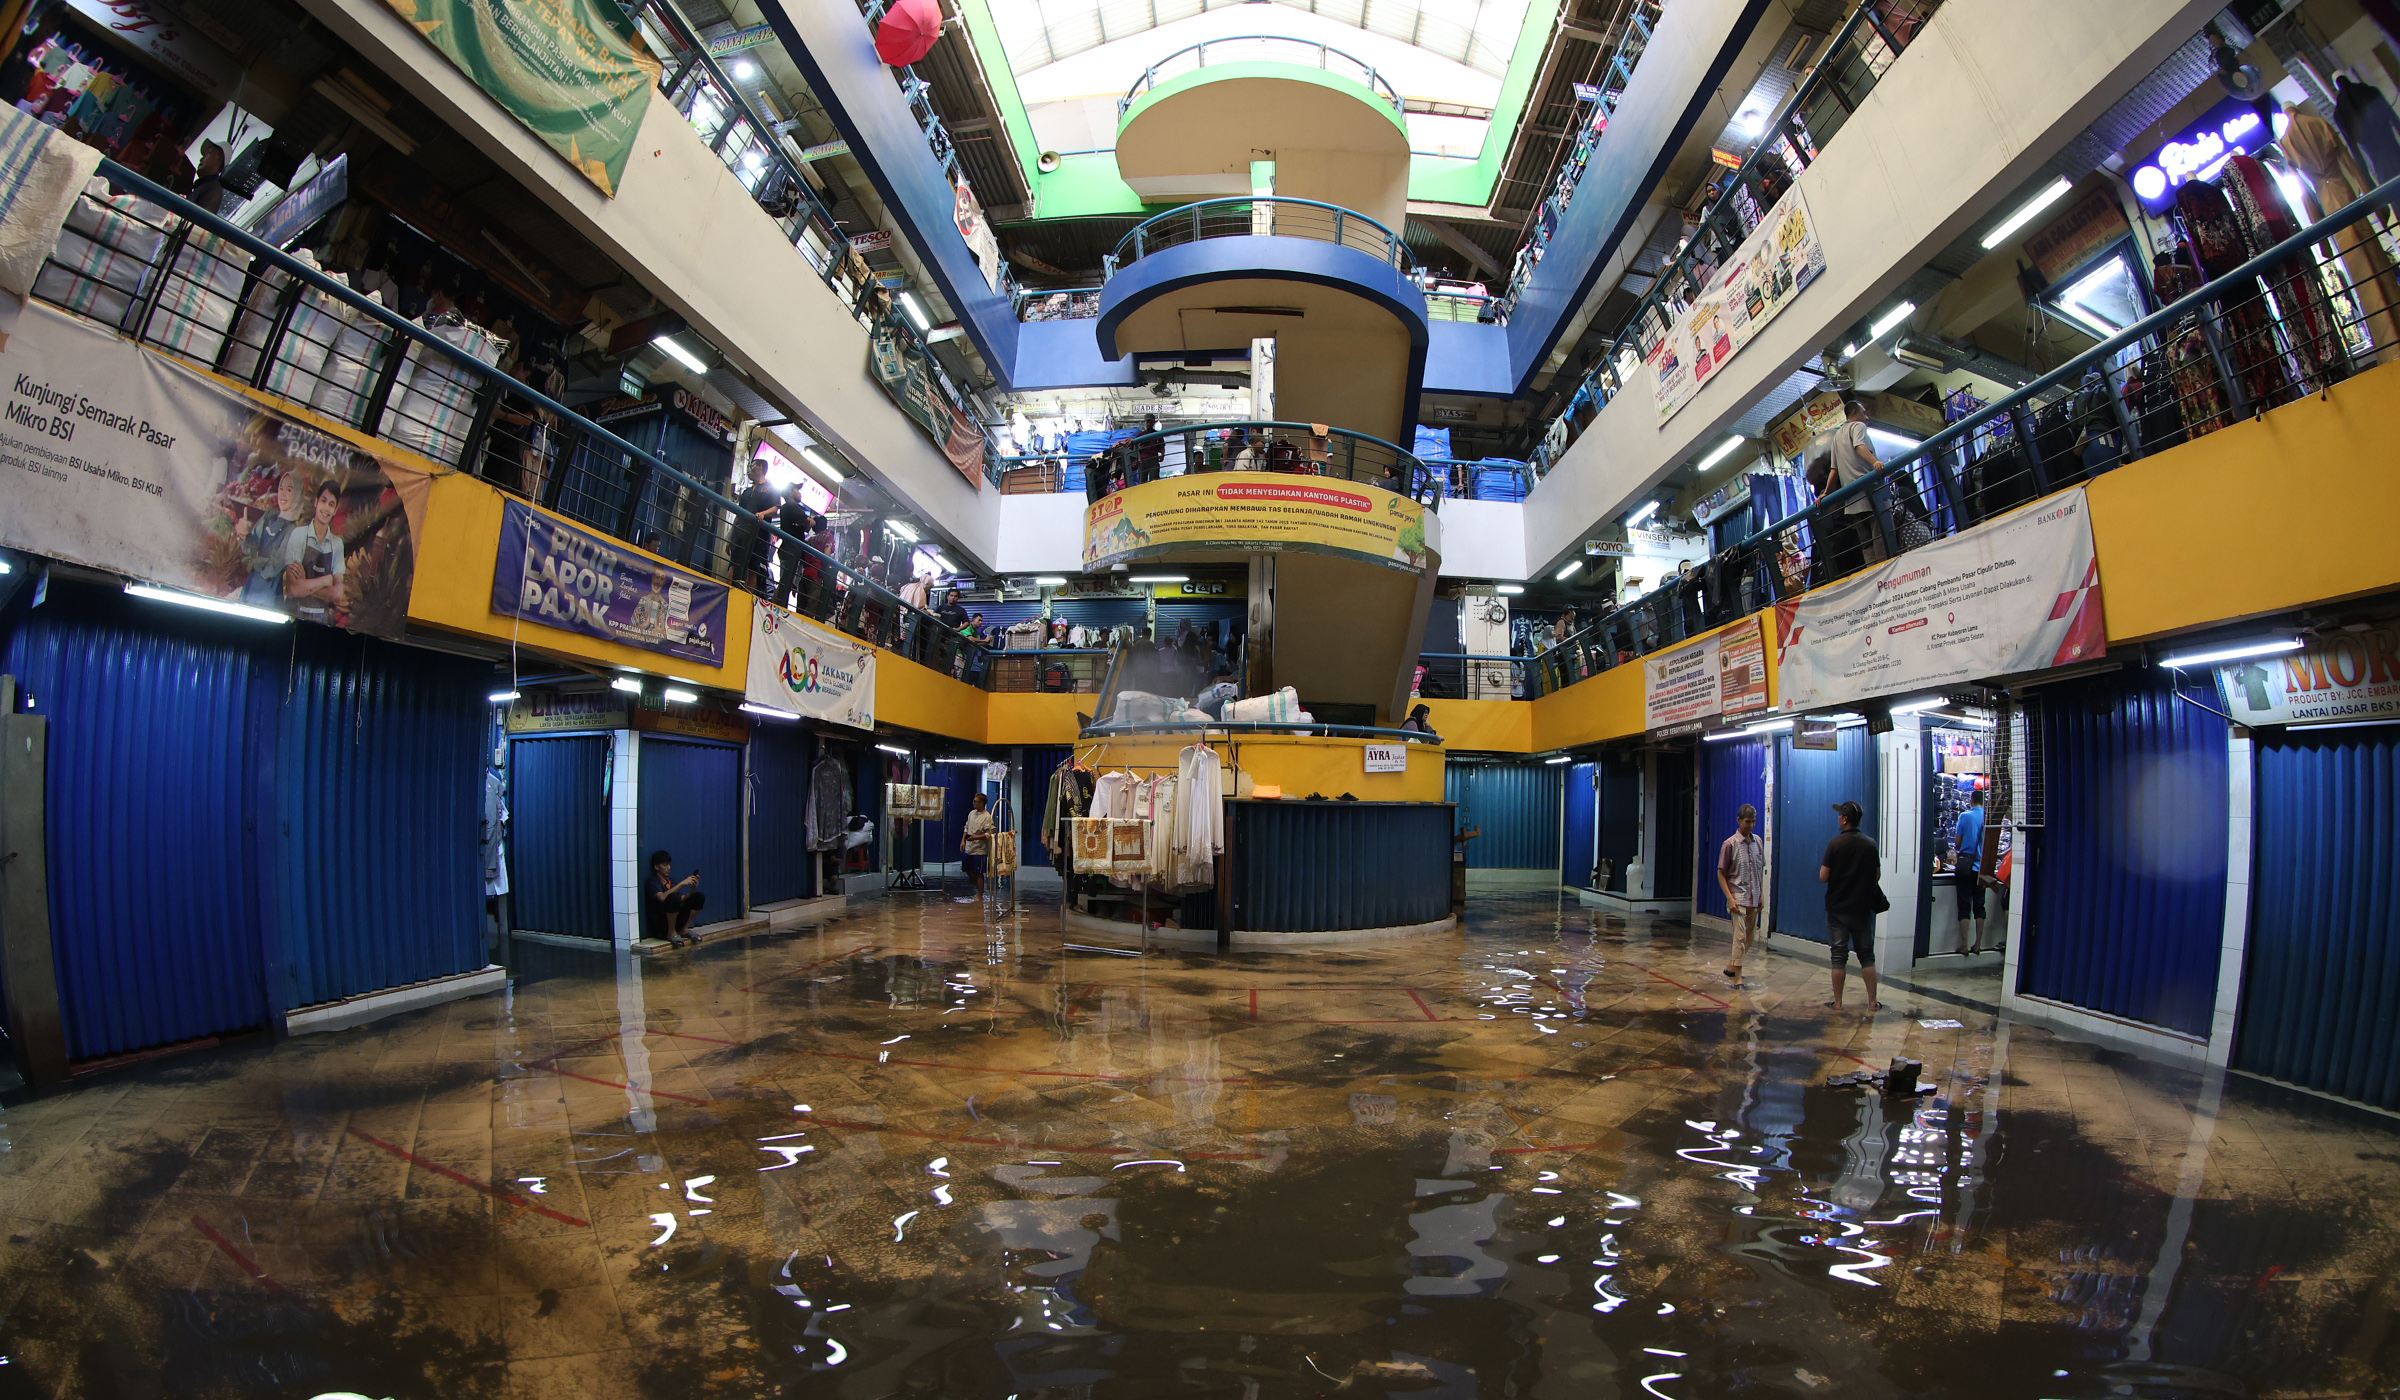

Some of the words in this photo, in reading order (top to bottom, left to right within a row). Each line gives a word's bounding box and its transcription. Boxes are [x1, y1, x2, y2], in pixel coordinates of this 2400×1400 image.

[535, 0, 574, 45] TEPAT
[2251, 3, 2276, 28] EXIT
[499, 13, 567, 82] BERKELANJUTAN
[712, 33, 751, 53] BONNAY
[750, 27, 775, 43] JAYA
[598, 46, 639, 92] BAYAR
[549, 40, 574, 71] PASAR
[572, 67, 592, 91] YANG
[590, 86, 614, 111] LEBIH
[610, 106, 632, 128] KUAT
[854, 230, 891, 245] TESCO
[623, 382, 639, 396] EXIT
[5, 401, 47, 432] Mikro
[49, 416, 76, 442] BSI
[14, 373, 77, 414] Kunjungi
[76, 397, 139, 435] Semarak
[138, 420, 176, 449] Pasar
[687, 394, 721, 432] KIALA
[278, 423, 354, 468] SEMARAK
[287, 439, 339, 475] PASAR
[0, 453, 27, 470] produk
[27, 460, 41, 474] BSI
[41, 464, 68, 483] lainnya
[23, 444, 68, 466] pembiayaan
[69, 456, 83, 470] BSI
[83, 461, 106, 478] Usaha
[106, 469, 130, 487] Mikro,
[131, 477, 145, 491] BSI
[145, 482, 164, 498] KUR
[1177, 488, 1201, 498] PASAR
[1202, 489, 1214, 497] INI
[1217, 487, 1244, 497] "TIDAK
[1246, 487, 1302, 499] MENYEDIAKAN
[1303, 491, 1339, 503] KANTONG
[1340, 496, 1371, 509] PLASTIK"
[1145, 507, 1184, 519] PENGUNJUNG
[1184, 505, 1229, 514] DIHARAPKAN
[1230, 504, 1266, 512] MEMBAWA
[1283, 507, 1339, 518] BELANJA/WADAH
[1340, 513, 1362, 524] RAMAH
[1363, 518, 1397, 532] LINGKUNGAN
[1389, 509, 1404, 518] pasar
[2037, 512, 2056, 525] BANK
[2063, 504, 2077, 517] DKI
[1595, 542, 1623, 552] KOIYO
[1637, 532, 1669, 542] VINSEN
[551, 527, 618, 577] PILIH
[525, 547, 614, 604] LAPOR
[1852, 606, 1869, 616] Tanggal
[1904, 589, 1919, 597] Kantor
[1920, 583, 1937, 593] Cabang
[1937, 576, 1961, 587] Pembantu
[1962, 571, 1976, 580] Pasar
[1977, 564, 1994, 576] Cipulir
[1995, 559, 2017, 570] Ditutup,
[1877, 566, 1932, 593] Pengumuman
[1947, 586, 1960, 594] Mitra
[1960, 581, 1976, 591] Usaha
[521, 579, 610, 634] PAJAK
[1928, 600, 1948, 611] Transaksi
[1949, 596, 1962, 605] Serta
[1962, 590, 1983, 601] Layanan
[1983, 585, 2000, 595] Dapat
[2000, 578, 2026, 590] Dilakukan
[608, 620, 619, 628] KPP
[620, 622, 641, 635] PRATAMA
[1936, 631, 1947, 639] Pasar
[822, 665, 854, 684] JAKARTA
[644, 695, 662, 707] EXIT
[2288, 693, 2328, 705] PRODUCT
[2331, 691, 2345, 701] BY:
[2347, 688, 2366, 700] JCC,
[2292, 707, 2329, 719] LANTAI
[2331, 704, 2369, 716] DASAR
[2371, 702, 2393, 713] BKS
[1656, 728, 1669, 738] POLSEK
[1669, 724, 1691, 736] KEBAYORAN
[1691, 721, 1703, 731] LAMA
[1871, 718, 1889, 732] EXIT
[1367, 750, 1390, 760] AYRA
